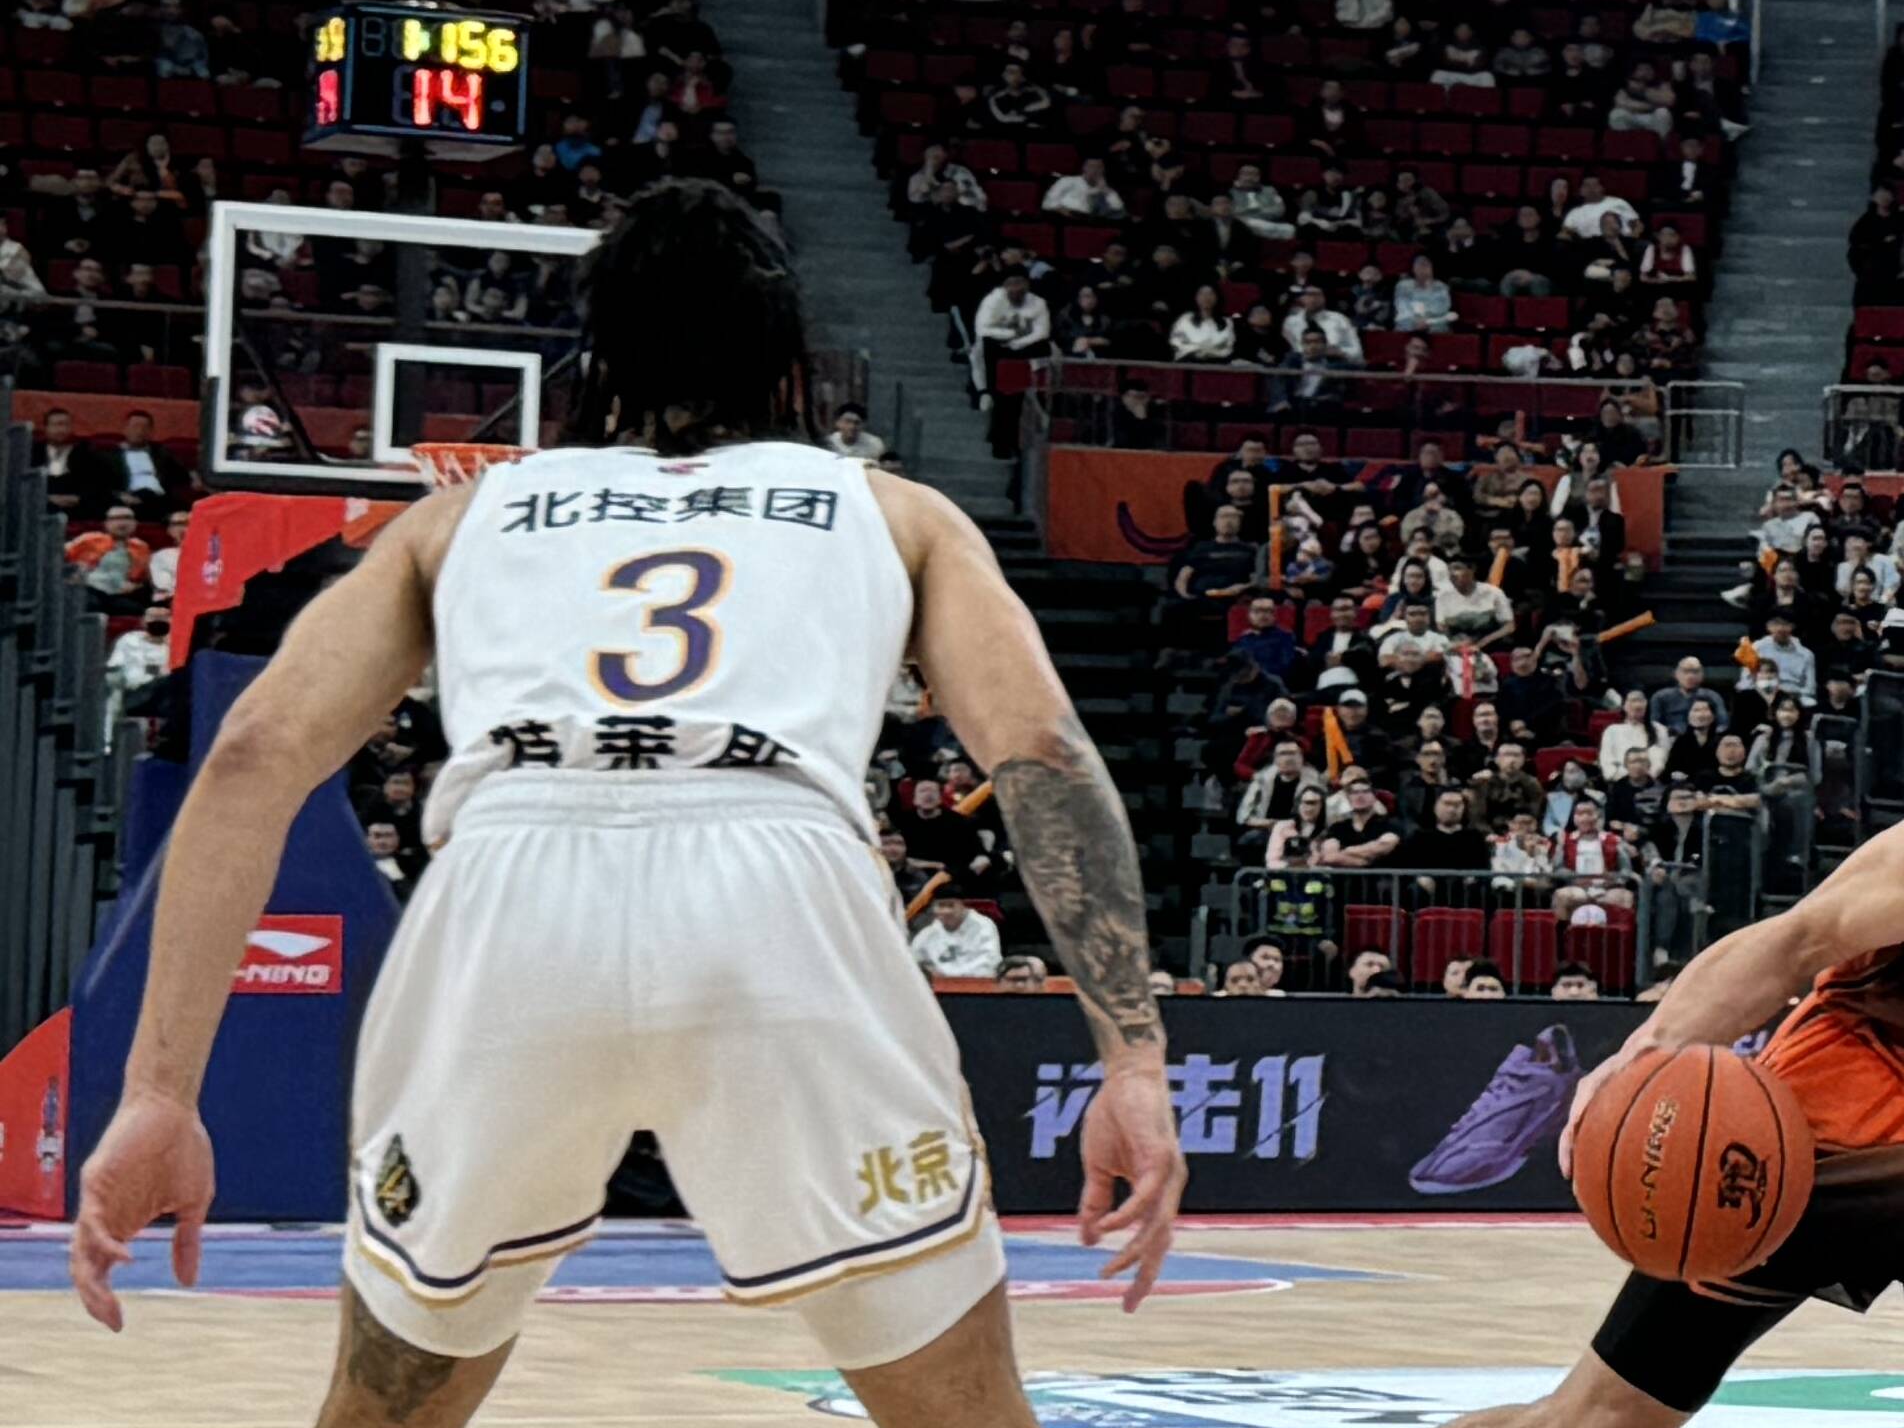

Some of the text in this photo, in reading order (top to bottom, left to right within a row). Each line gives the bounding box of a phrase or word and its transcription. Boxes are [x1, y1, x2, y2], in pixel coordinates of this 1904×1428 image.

[414, 68, 483, 130] 14
[501, 485, 838, 533] 北控集团
[586, 545, 735, 711] 3
[234, 963, 333, 987] -NING
[857, 1130, 959, 1213] 北京
